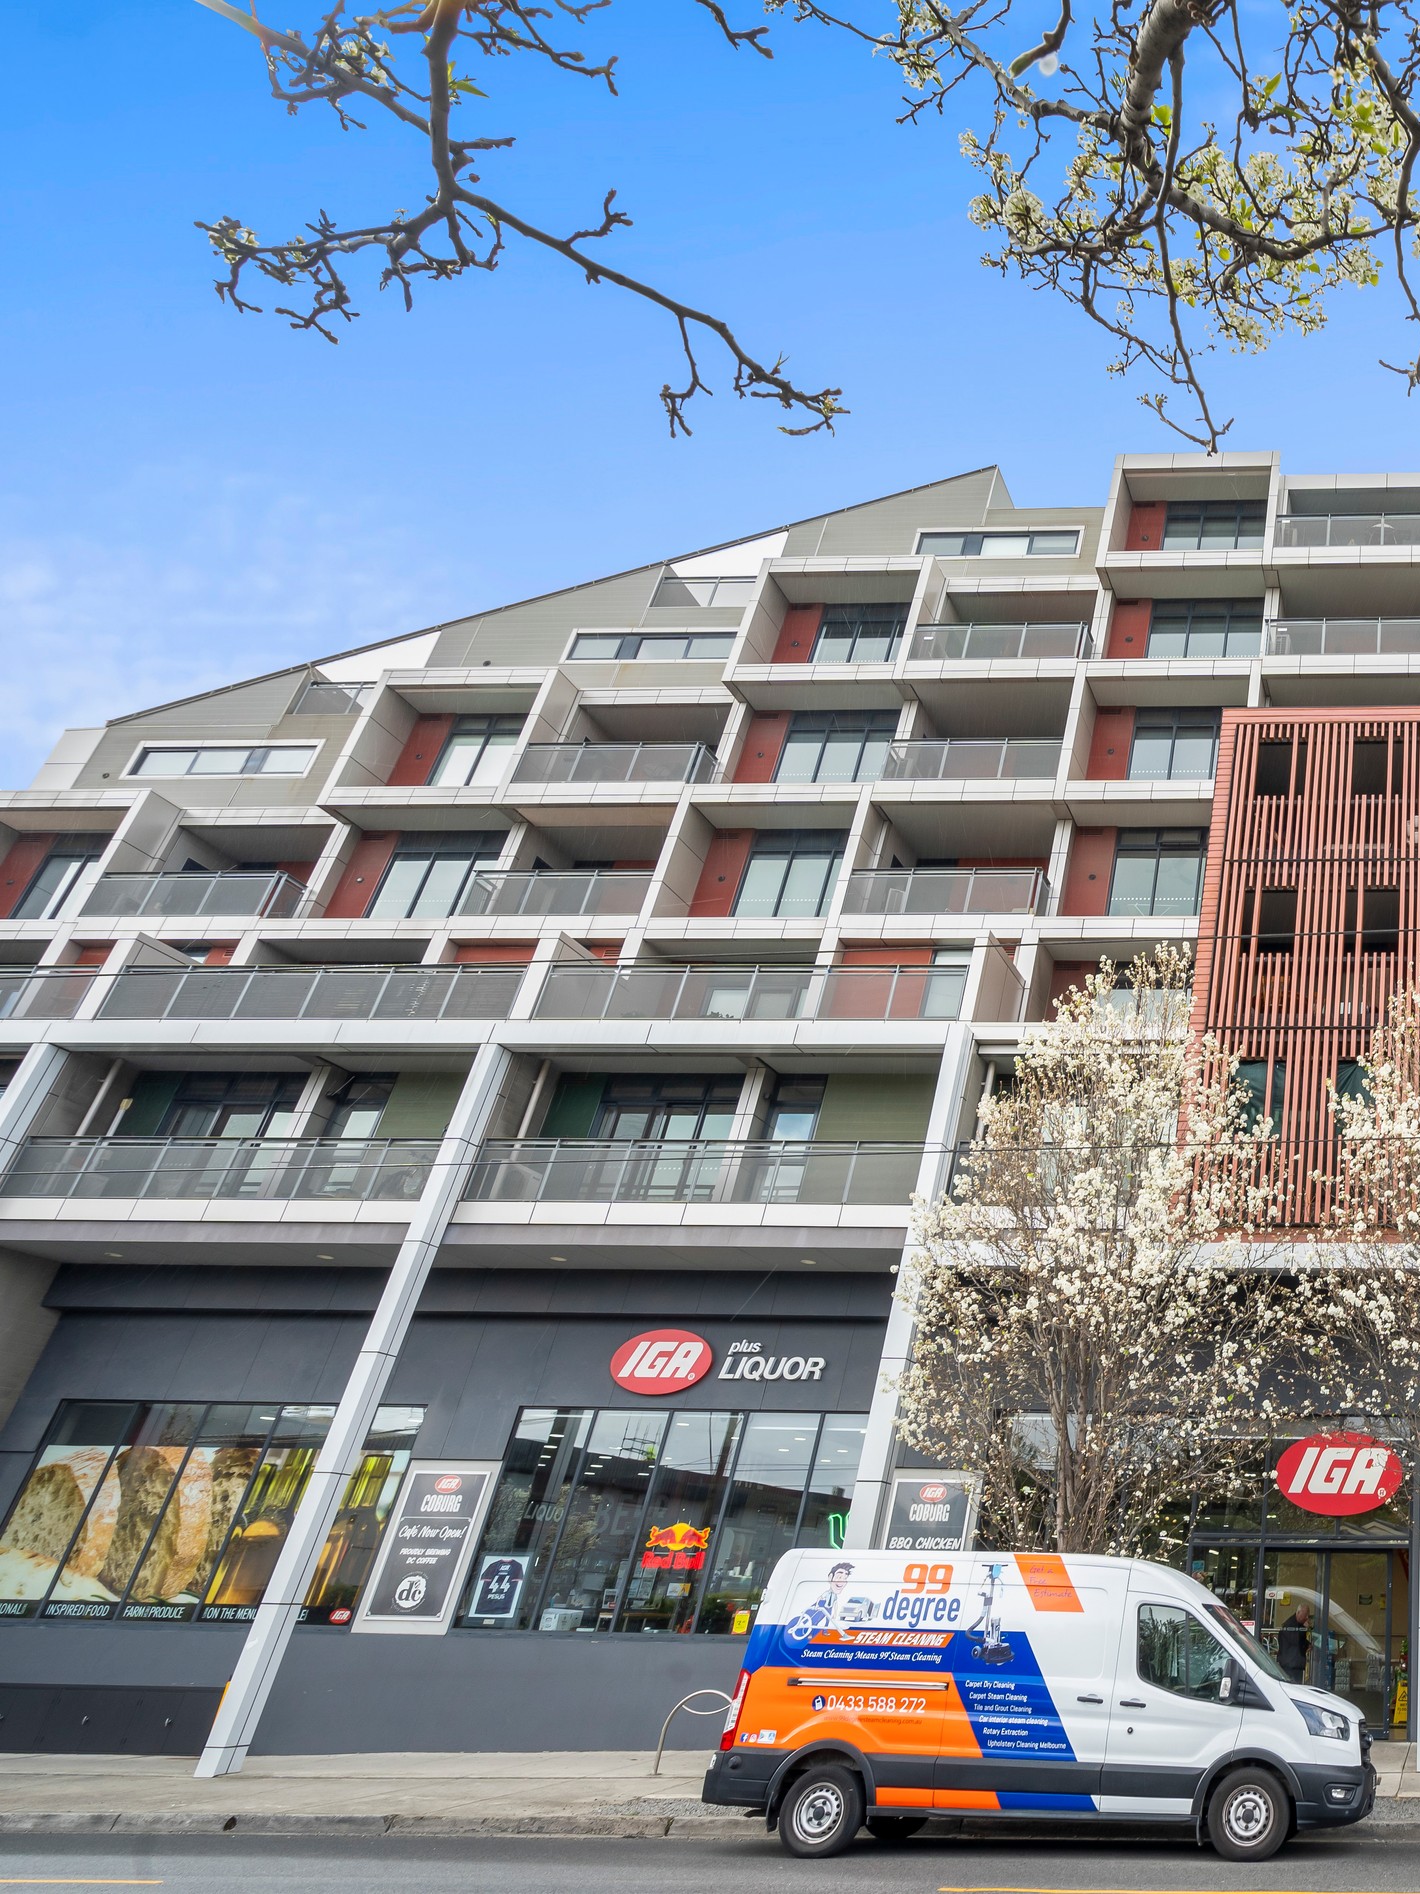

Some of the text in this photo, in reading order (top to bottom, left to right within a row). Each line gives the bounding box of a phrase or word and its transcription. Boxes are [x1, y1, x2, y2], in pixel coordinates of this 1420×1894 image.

[728, 1339, 763, 1355] plus
[617, 1342, 704, 1378] IGA
[718, 1356, 826, 1381] LIQUOR
[1288, 1447, 1389, 1494] IGA
[437, 1478, 460, 1488] IGA
[922, 1487, 943, 1498] IGA
[420, 1494, 463, 1512] COBURG
[523, 1502, 564, 1522] LIQUO
[909, 1504, 950, 1521] COBURG
[398, 1524, 468, 1540] Café Now Open!
[889, 1537, 962, 1550] BBQ CHICKEN
[641, 1551, 706, 1569] Red Bull
[489, 1576, 510, 1593] 44
[901, 1564, 954, 1594] 99
[1034, 1588, 1072, 1598] Estimate
[46, 1604, 110, 1616] INSPIRED FOOD
[123, 1606, 145, 1617] FARM
[150, 1606, 186, 1618] PRODUCE
[207, 1608, 220, 1618] ON
[220, 1608, 236, 1619] THE
[331, 1611, 350, 1620] IGA
[882, 1590, 960, 1628] degree
[854, 1632, 947, 1646] STEAM CLEANING
[801, 1649, 822, 1658] Steam
[824, 1649, 853, 1661] Cleaning
[855, 1651, 878, 1660] Means
[890, 1652, 910, 1660] Steam
[912, 1652, 942, 1664] Cleaning
[965, 1680, 1015, 1690] Carpet Dry Cleaning
[969, 1692, 986, 1700] Carpet
[1005, 1693, 1027, 1702] Cleaning
[827, 1696, 926, 1714] 0433 588 272
[994, 1704, 1009, 1712] Grout
[1010, 1705, 1032, 1714] Cleaning
[1026, 1717, 1048, 1726] cleaning
[983, 1727, 1028, 1736] Rotary Extraction
[988, 1740, 1016, 1748] Upholstery
[1016, 1740, 1038, 1749] Cleaning
